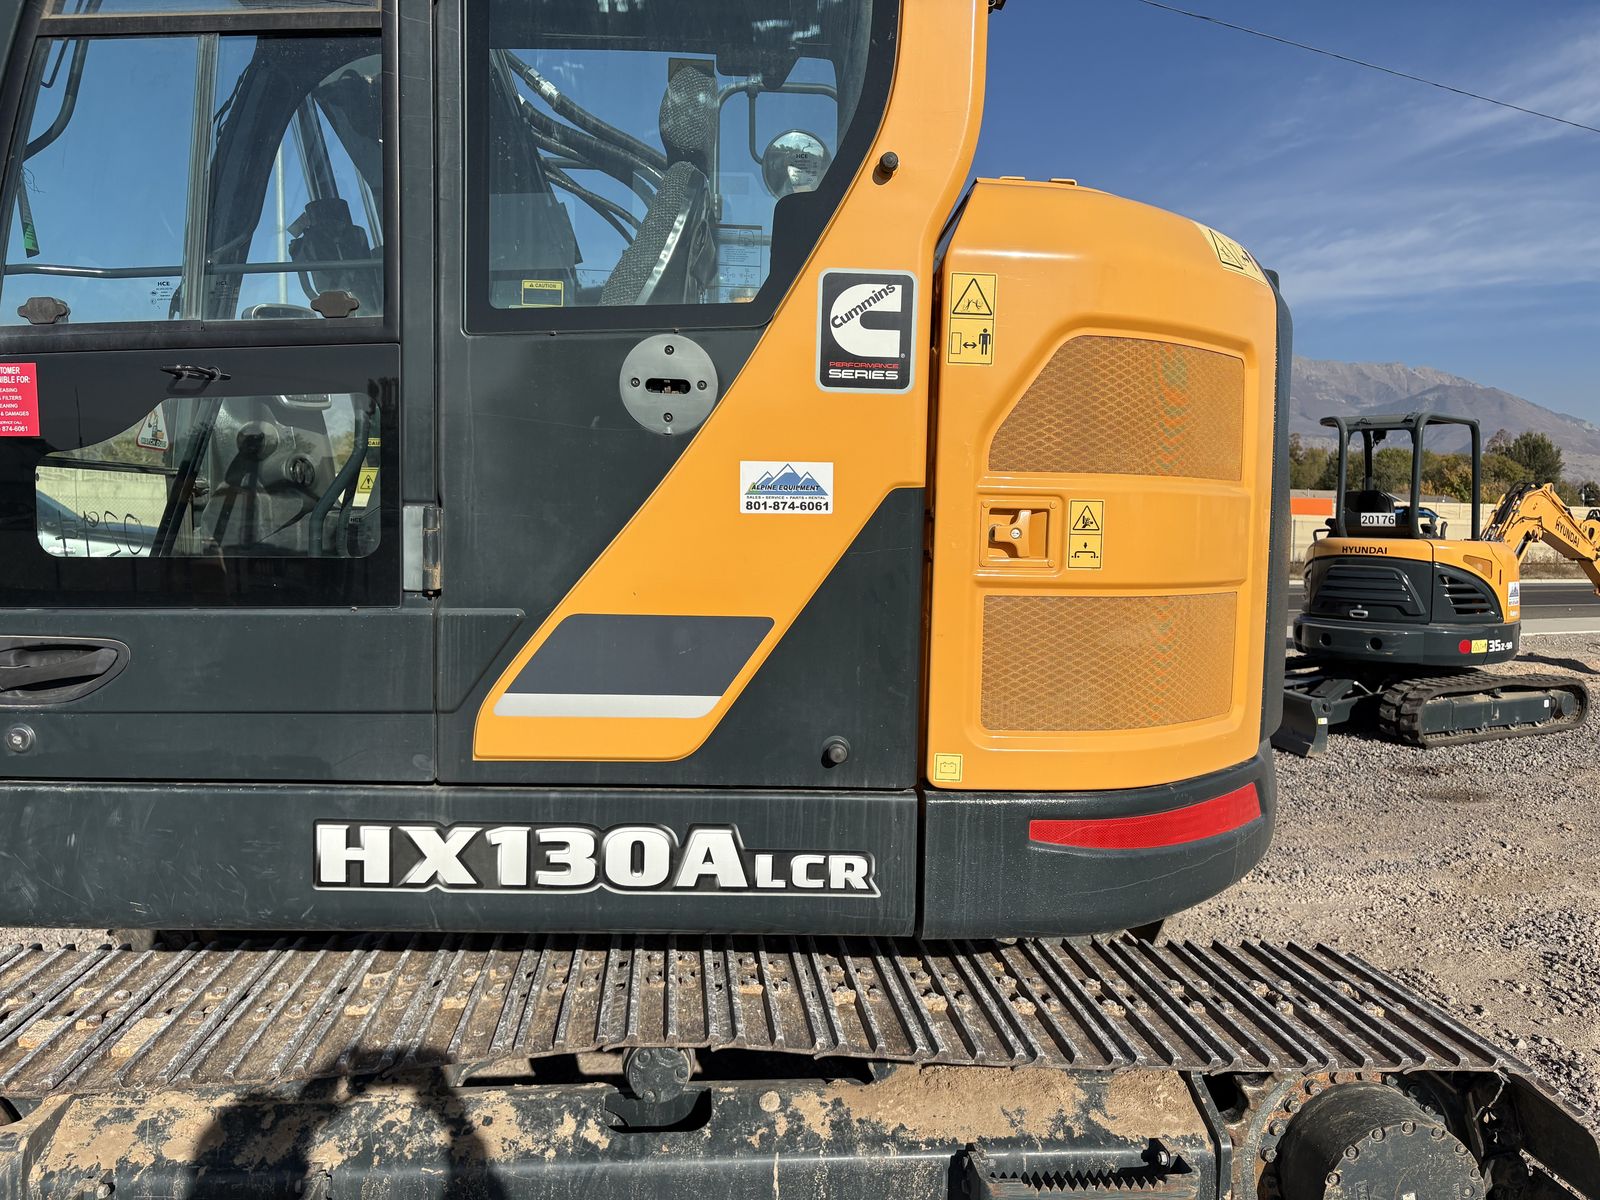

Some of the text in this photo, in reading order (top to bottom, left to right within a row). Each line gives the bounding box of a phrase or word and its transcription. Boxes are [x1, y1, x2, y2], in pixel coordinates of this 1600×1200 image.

[831, 284, 896, 329] Cummins
[829, 361, 899, 369] PERFORMANCE
[828, 369, 899, 380] SERIES
[745, 500, 829, 511] 801-874-6061
[1361, 515, 1395, 525] 20176
[1555, 519, 1580, 548] HYUNDAI
[1342, 545, 1388, 555] HYUNDAI
